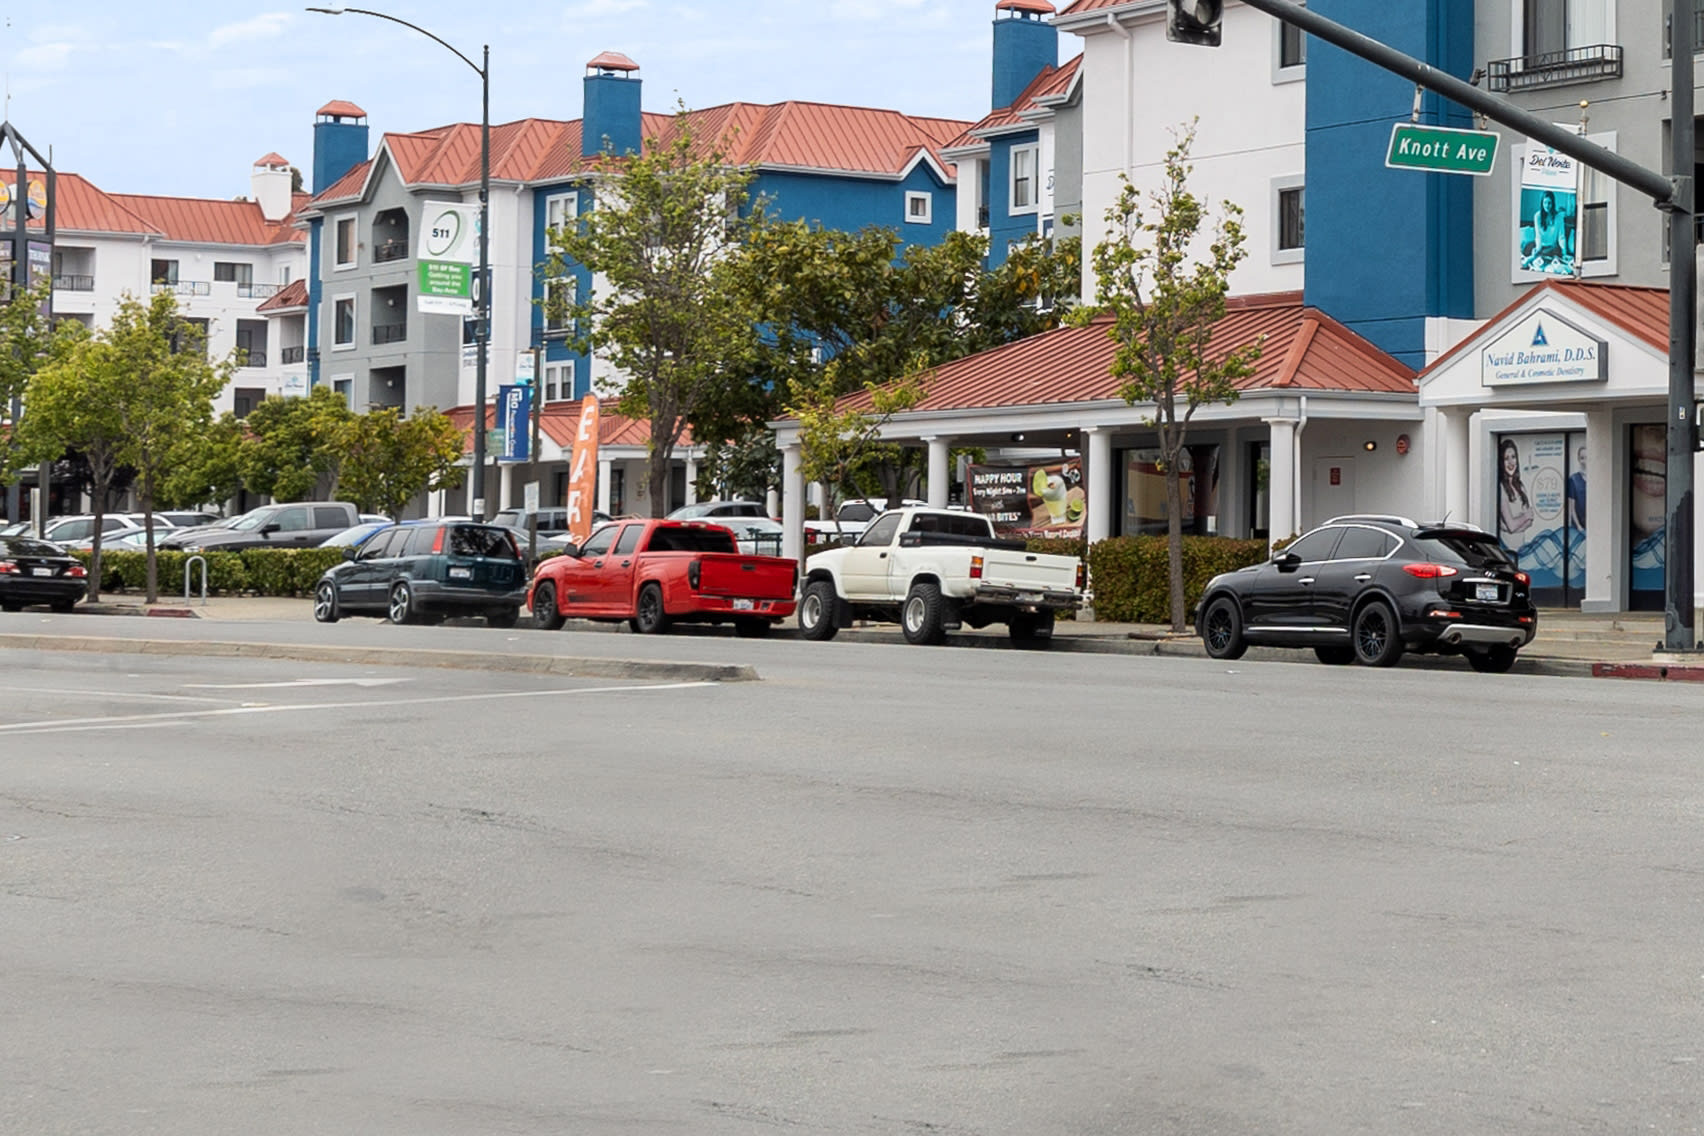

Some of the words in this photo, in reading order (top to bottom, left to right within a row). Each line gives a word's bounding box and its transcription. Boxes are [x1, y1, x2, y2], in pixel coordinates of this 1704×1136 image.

[1399, 137, 1450, 158] Knott
[1456, 144, 1487, 161] Ave
[432, 228, 450, 238] 511
[1487, 351, 1515, 366] Navid
[1516, 350, 1561, 365] Bahrami,
[1564, 347, 1596, 362] D.D.S.
[974, 474, 999, 484] HAPPY
[1000, 473, 1022, 484] HOUR
